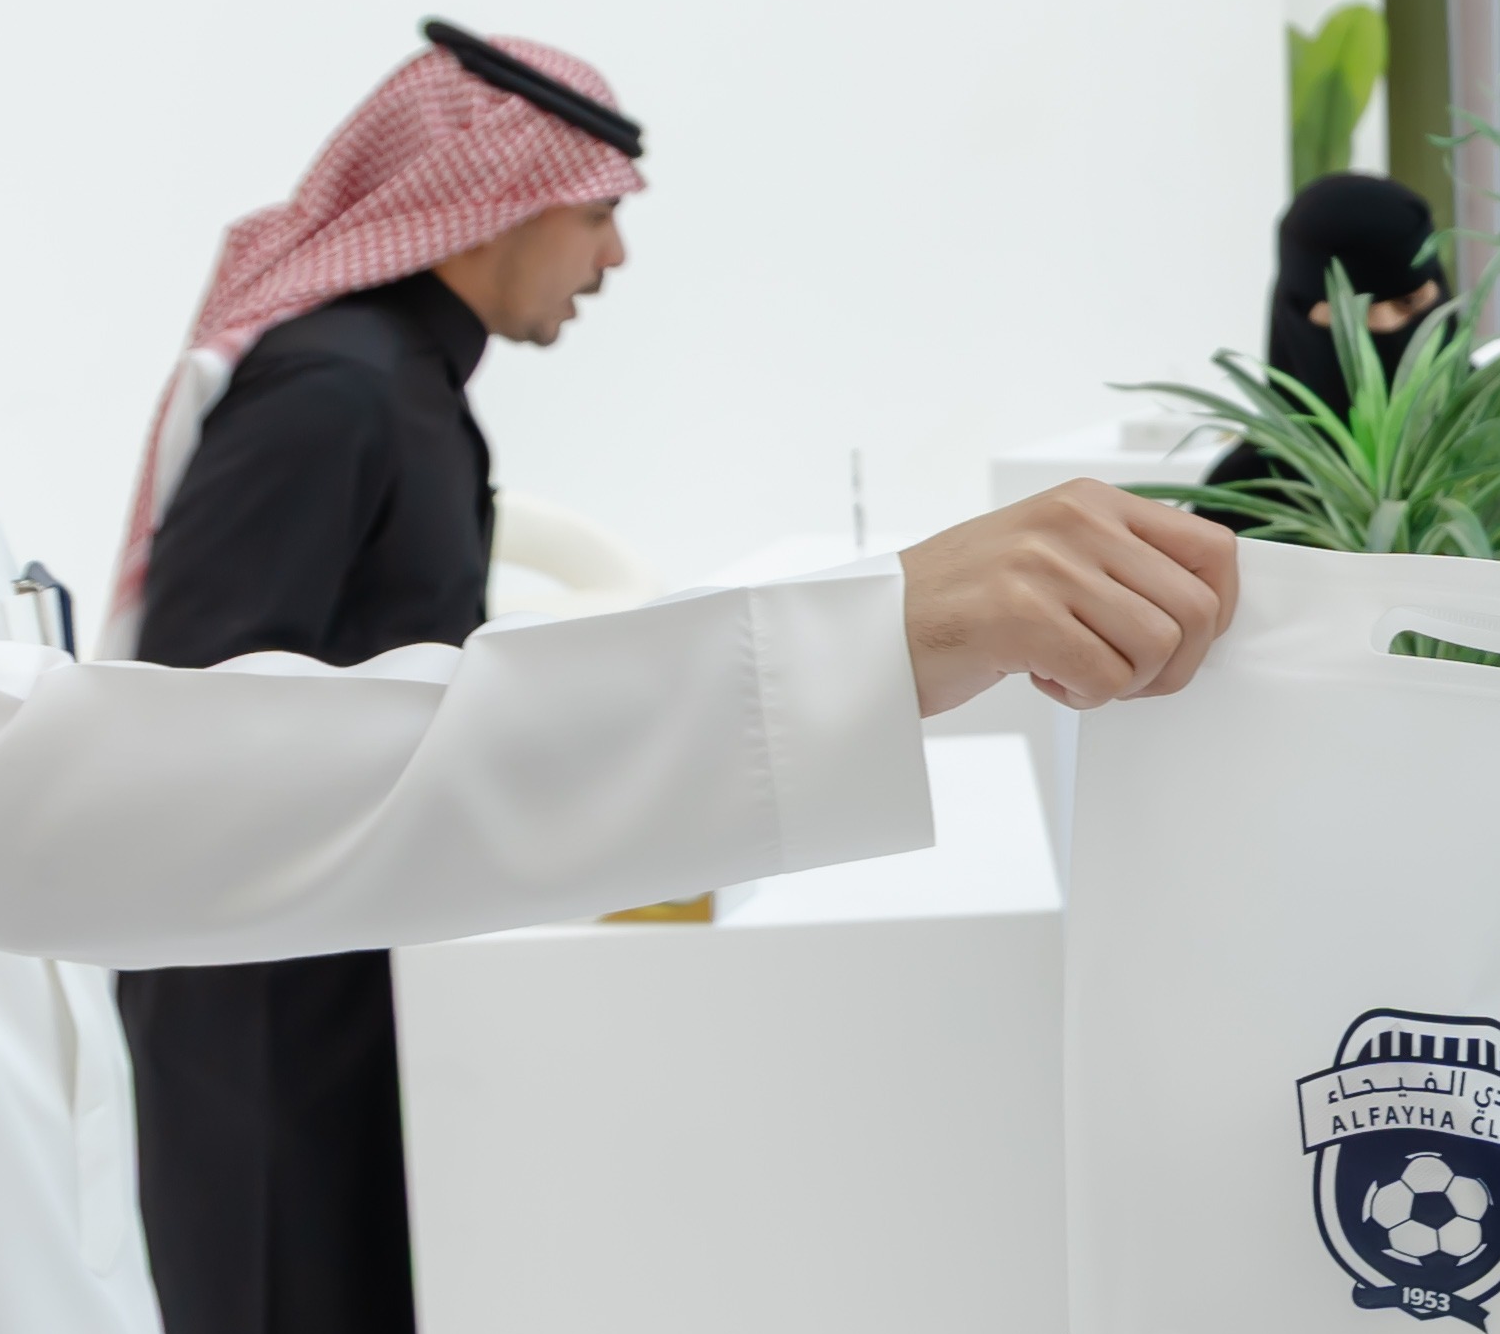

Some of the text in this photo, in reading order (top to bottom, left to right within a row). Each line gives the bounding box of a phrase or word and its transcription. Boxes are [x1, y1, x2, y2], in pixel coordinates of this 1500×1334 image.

[1327, 1070, 1467, 1105] الفيحاء
[1331, 1105, 1456, 1136] ALFAYHA
[1402, 1286, 1451, 1312] 1953
